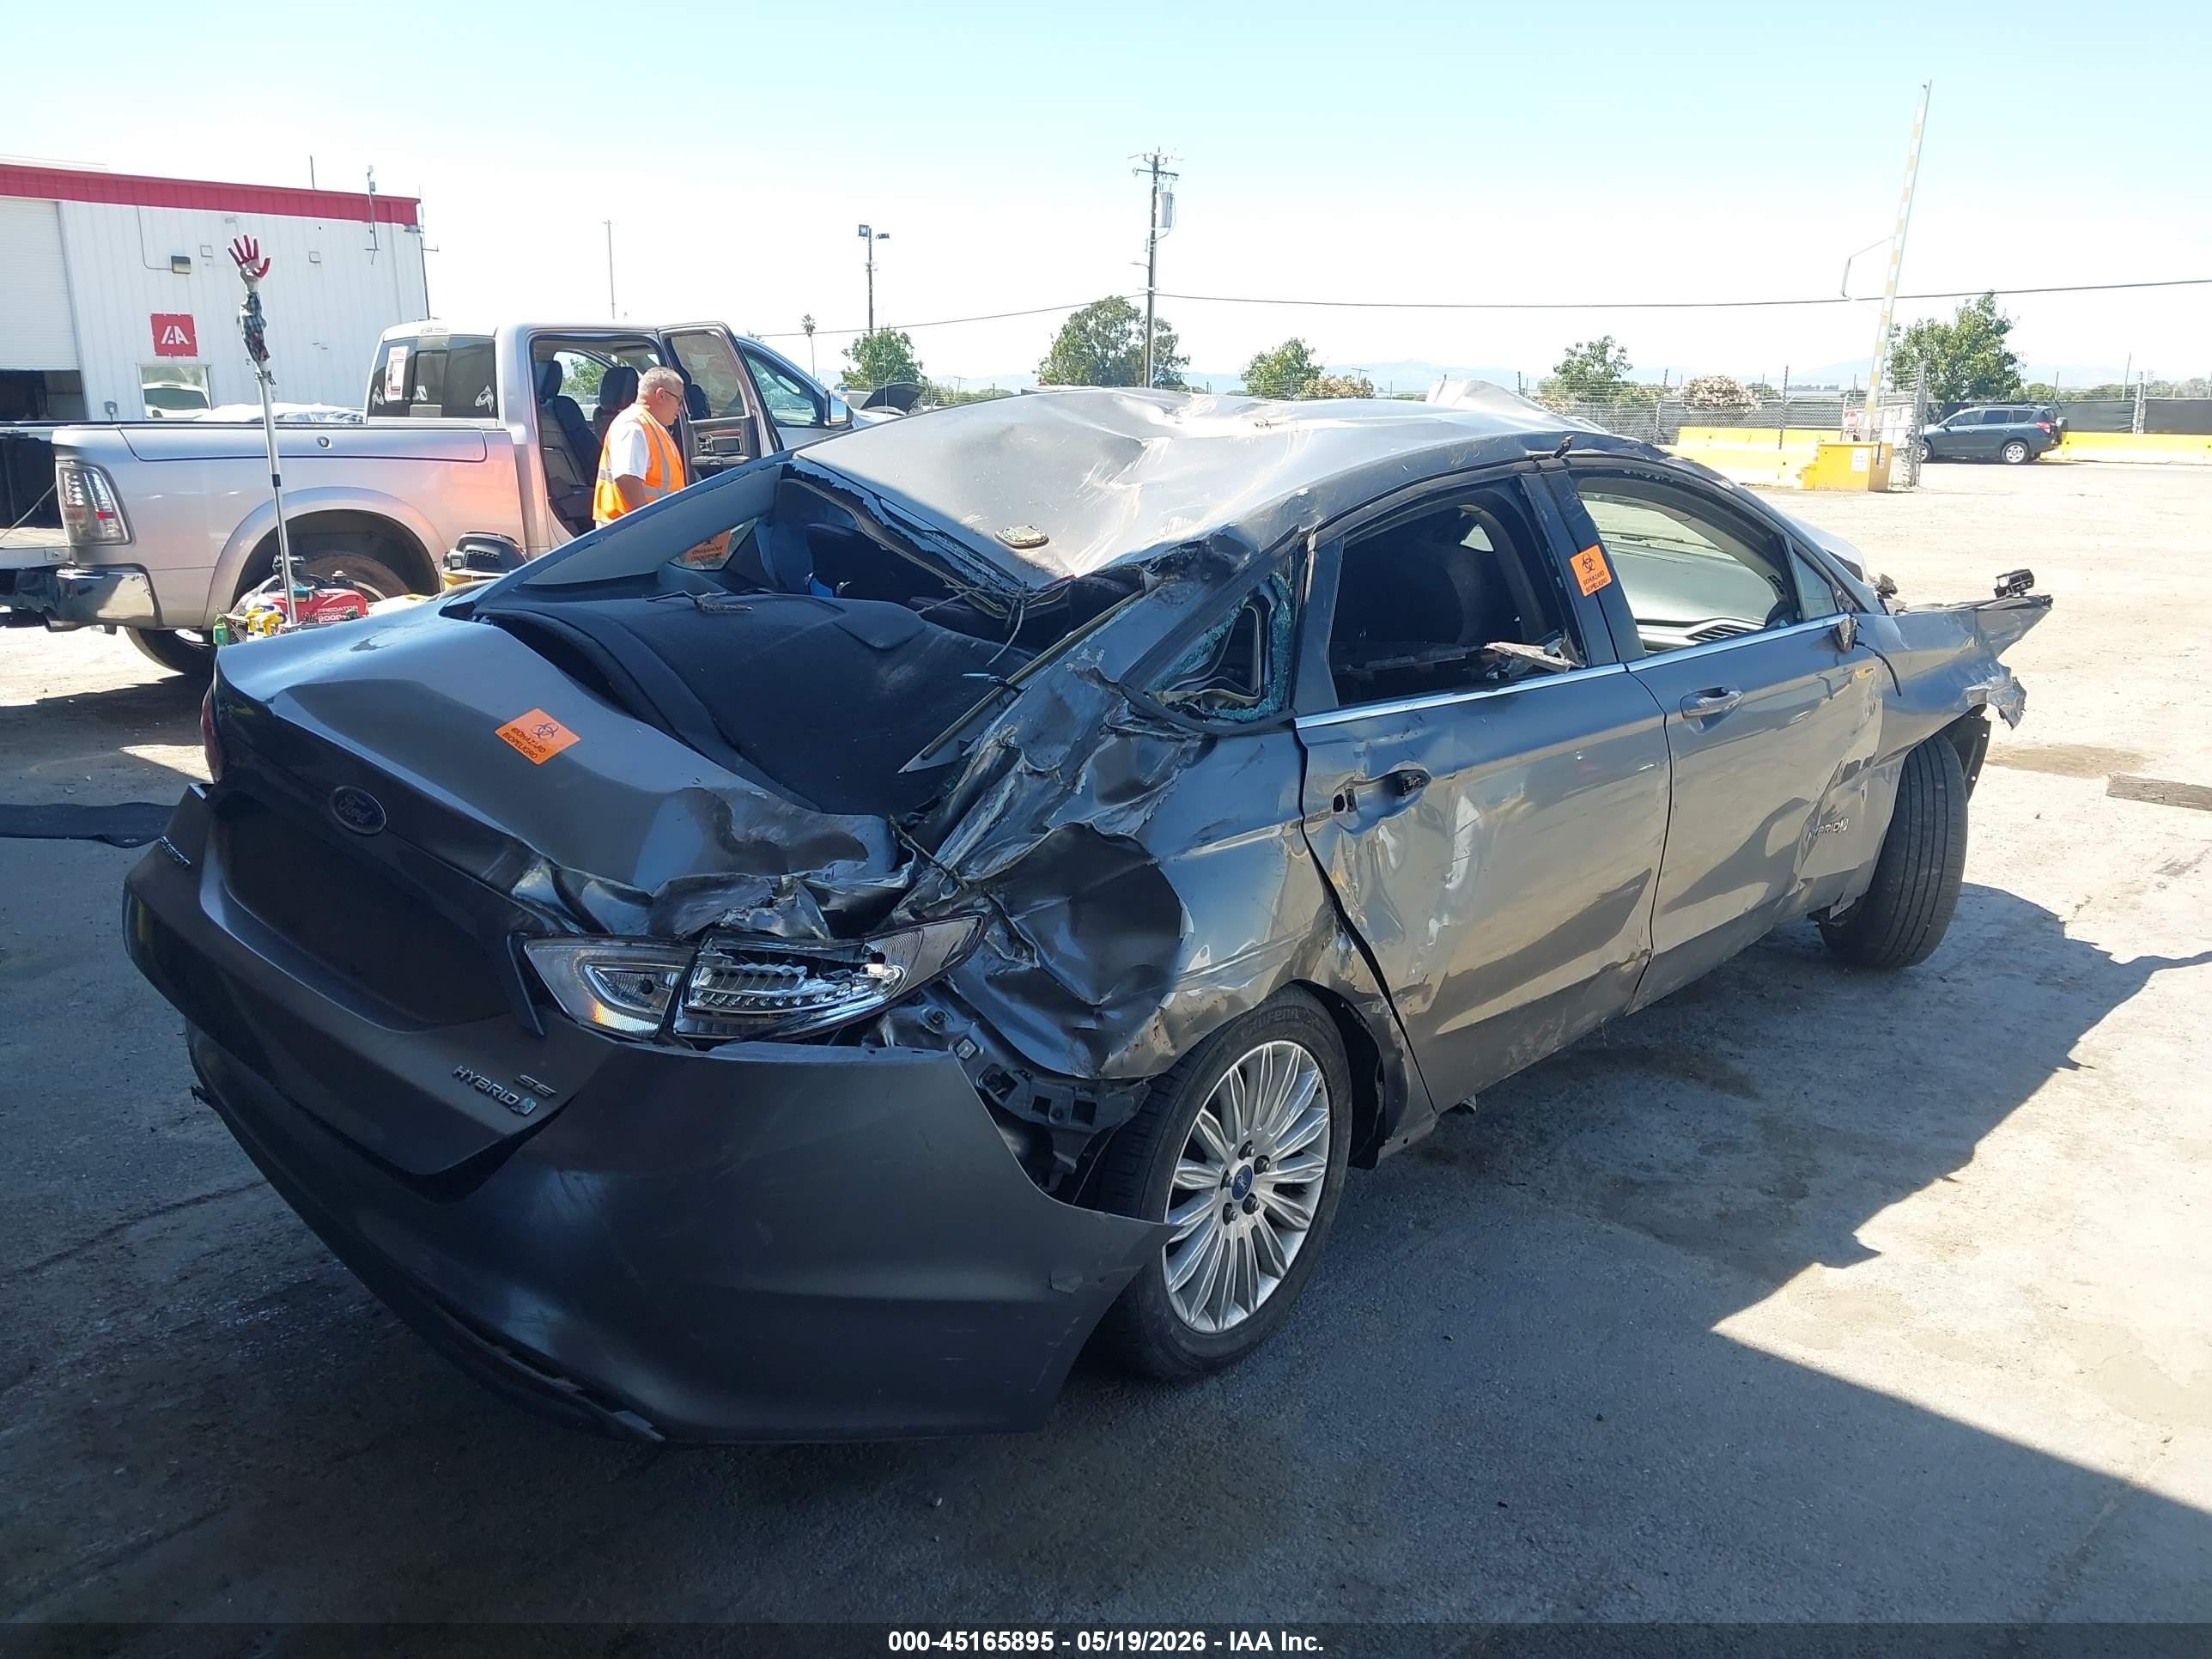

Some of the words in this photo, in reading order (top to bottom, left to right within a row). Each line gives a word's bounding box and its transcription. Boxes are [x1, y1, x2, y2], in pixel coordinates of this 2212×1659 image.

[501, 732, 538, 759] BIOPELIGRO
[510, 727, 546, 753] BIOHAZARD
[453, 1065, 520, 1105] HYBRID
[515, 1074, 557, 1097] SE
